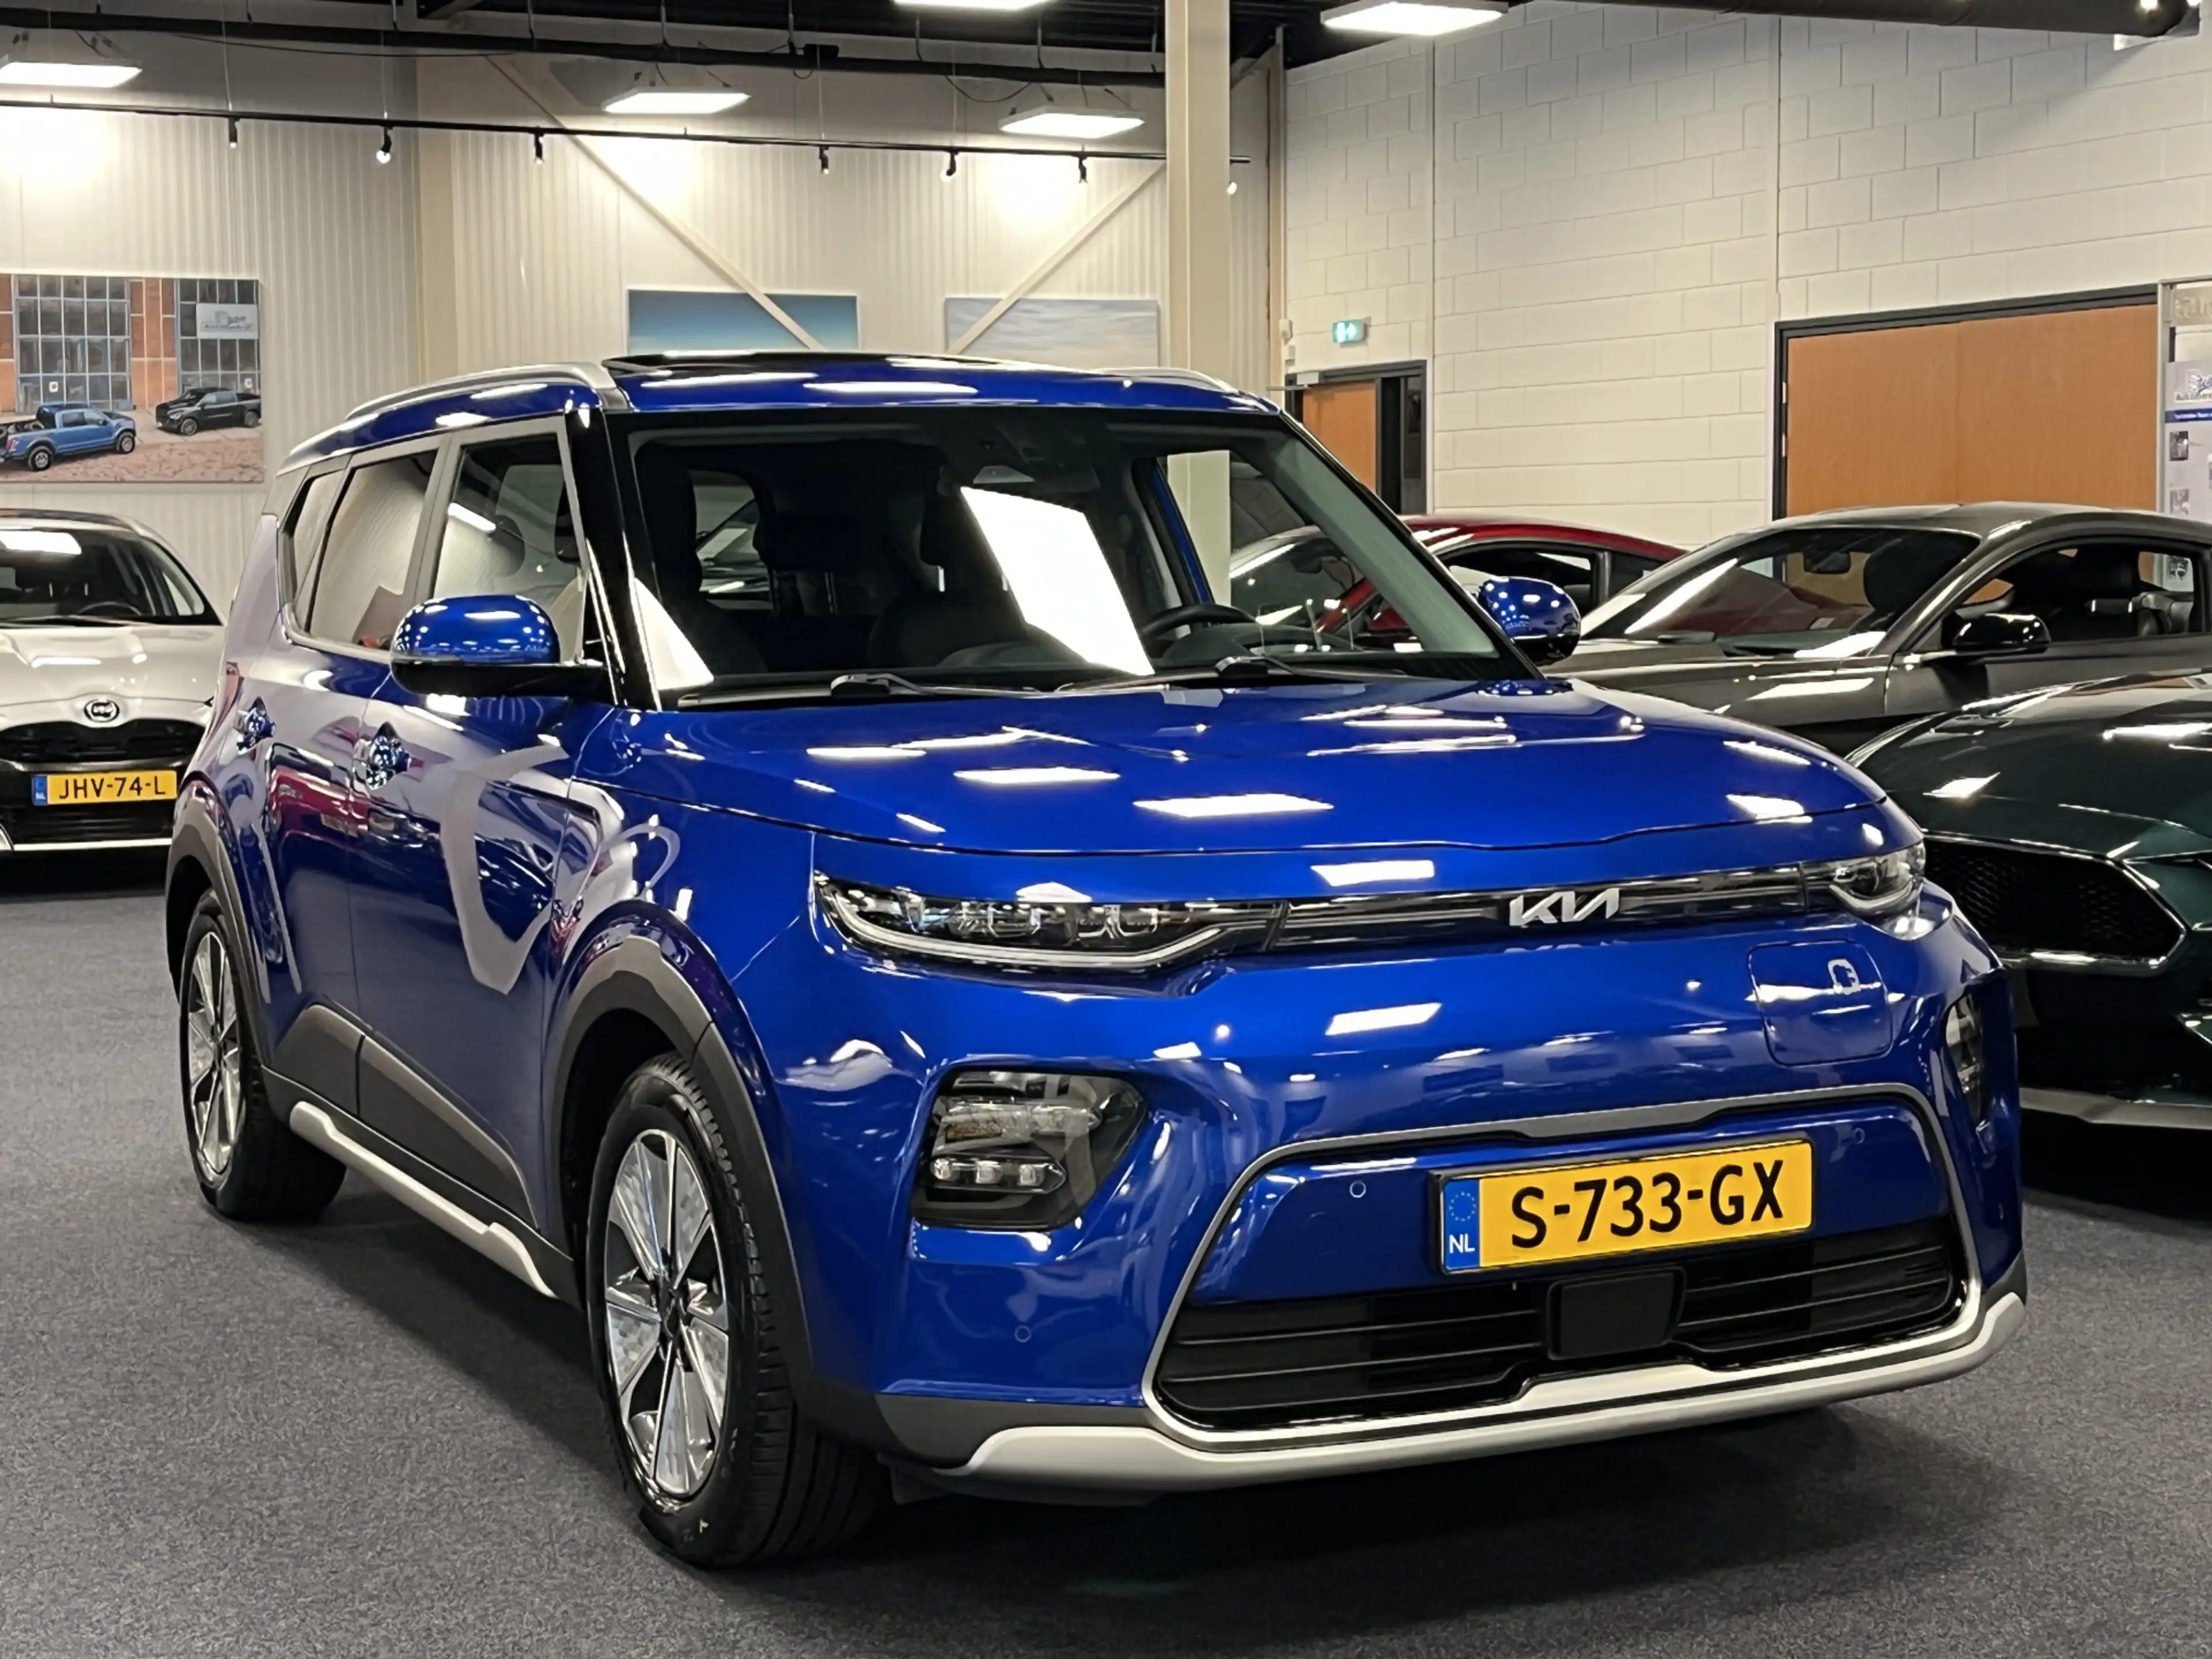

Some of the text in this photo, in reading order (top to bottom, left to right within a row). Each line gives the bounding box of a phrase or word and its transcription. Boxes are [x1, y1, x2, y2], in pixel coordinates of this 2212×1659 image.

[59, 775, 166, 800] JHV-74-L
[1509, 888, 1619, 926] KIA
[1511, 1160, 1783, 1248] S-733-GX
[1449, 1233, 1475, 1254] NL
